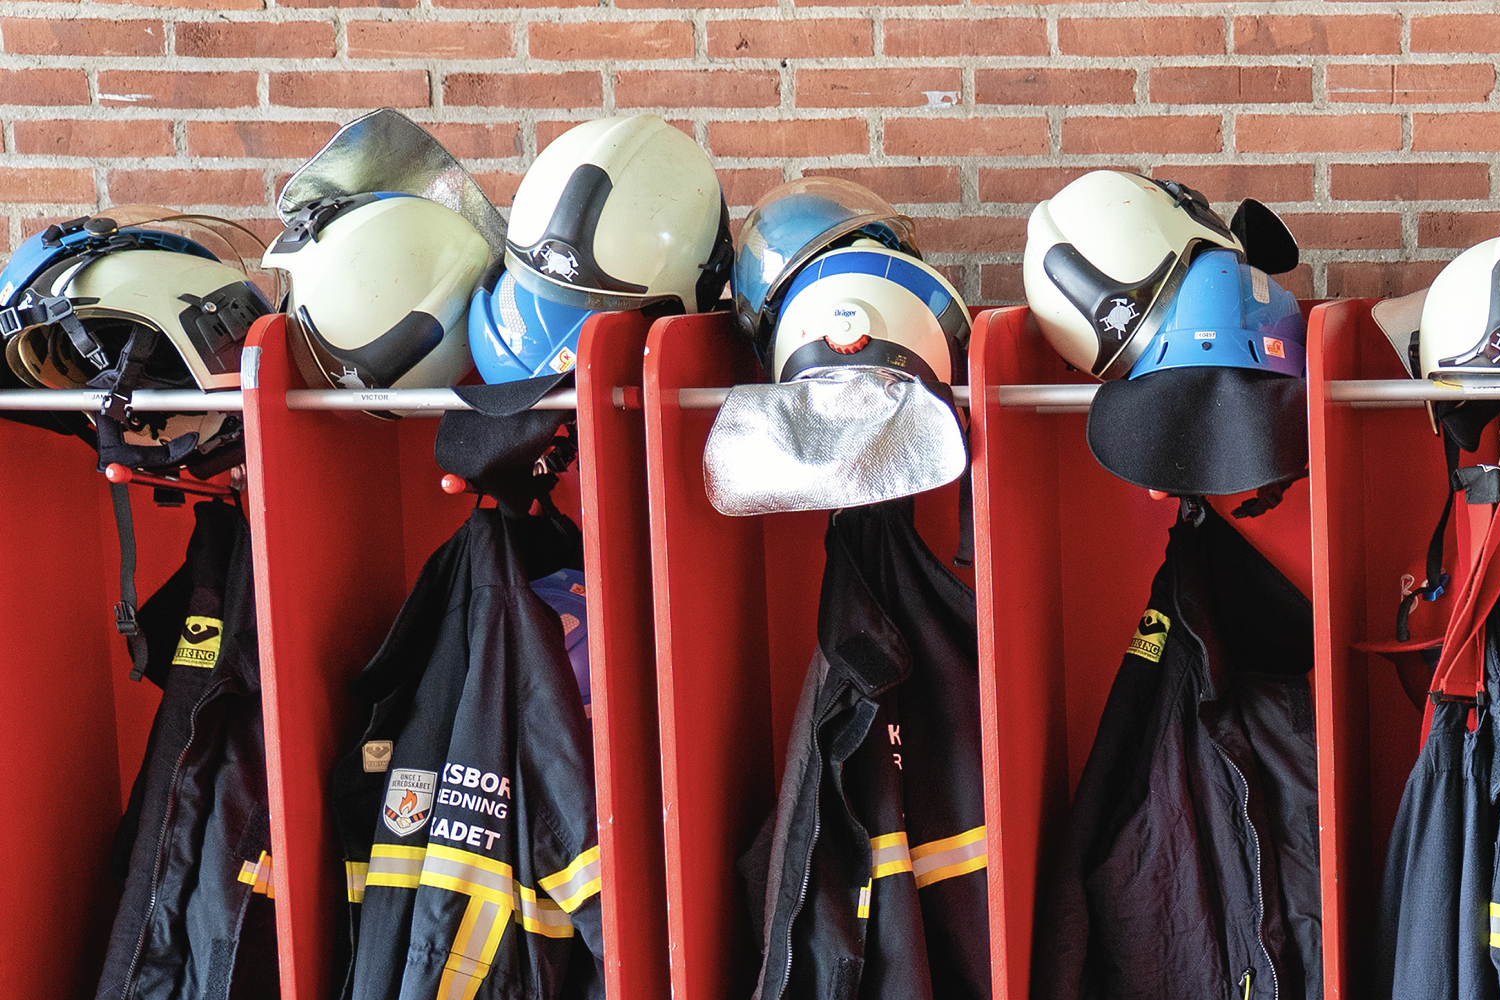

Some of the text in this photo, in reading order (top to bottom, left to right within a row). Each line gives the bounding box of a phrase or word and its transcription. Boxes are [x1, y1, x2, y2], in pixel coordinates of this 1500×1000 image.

[834, 308, 857, 318] Dräger
[1131, 638, 1160, 656] IKING
[437, 788, 508, 819] EDNING
